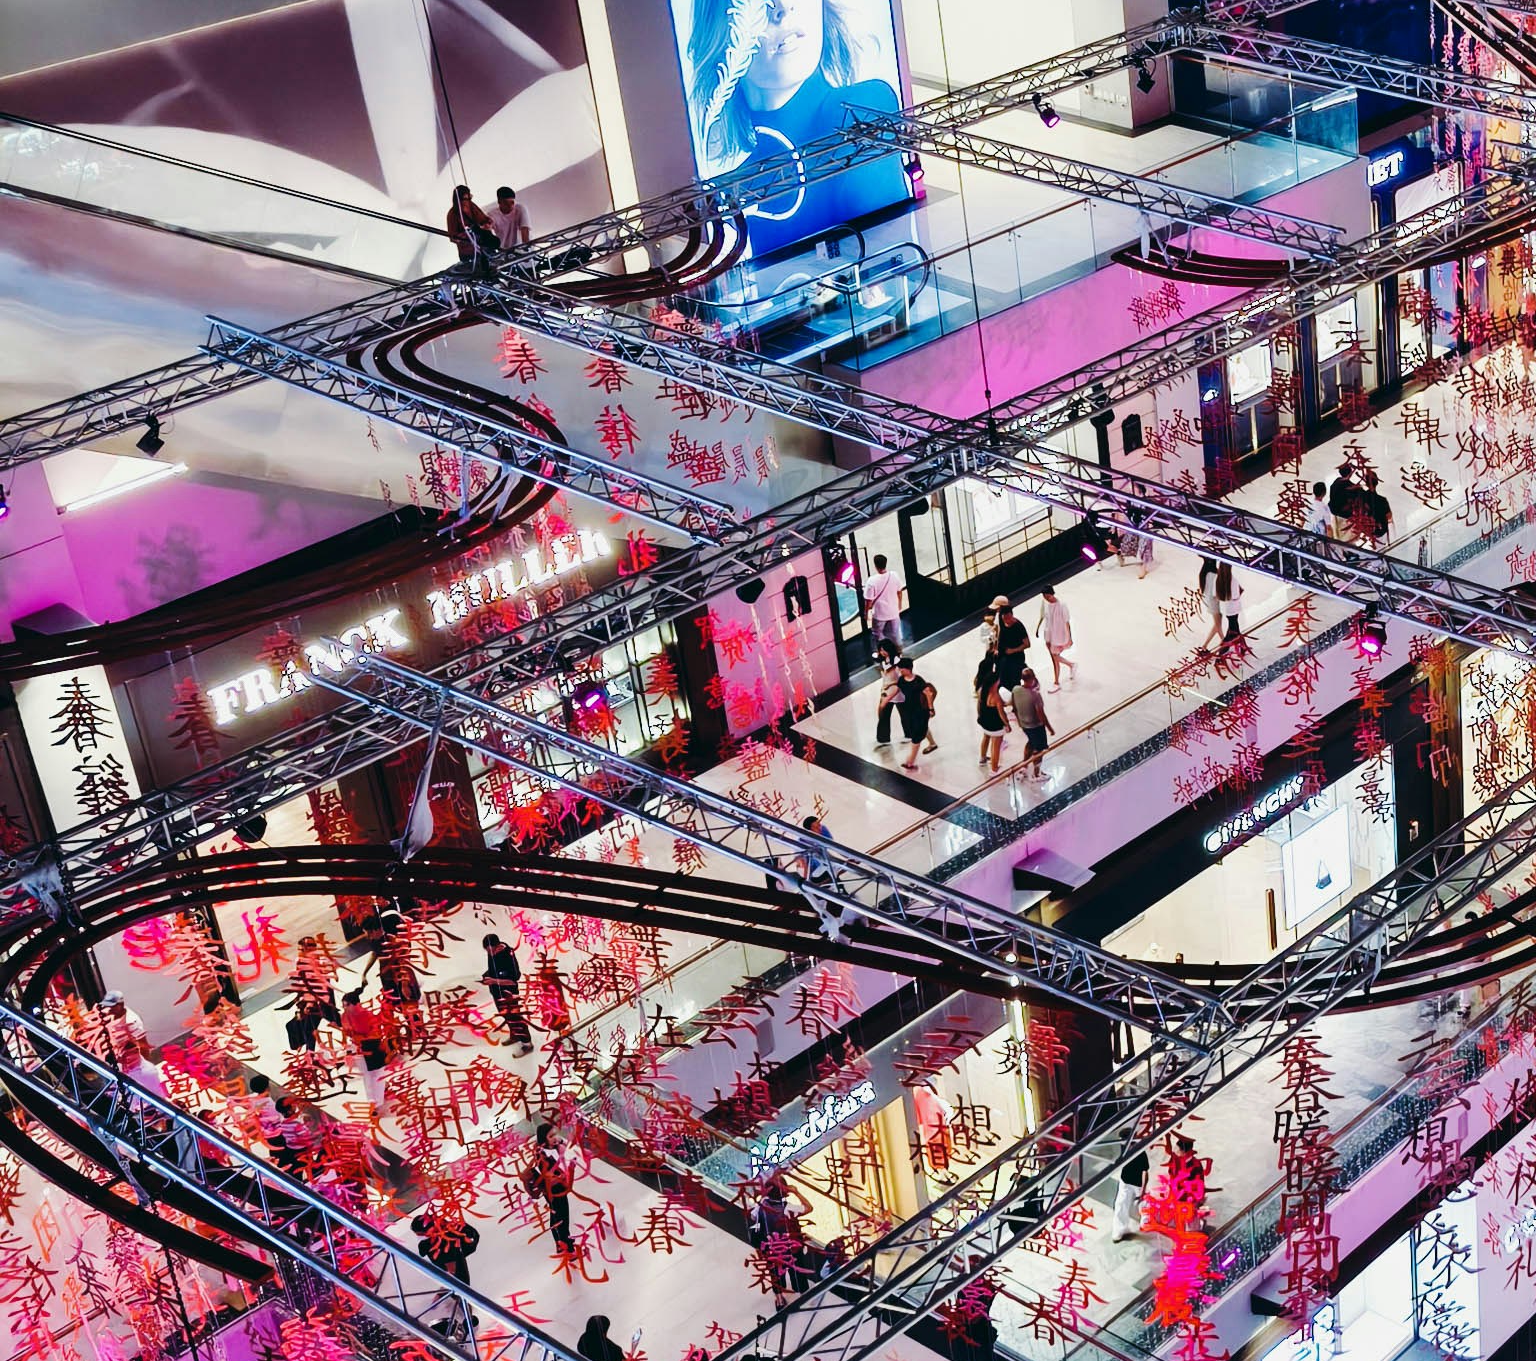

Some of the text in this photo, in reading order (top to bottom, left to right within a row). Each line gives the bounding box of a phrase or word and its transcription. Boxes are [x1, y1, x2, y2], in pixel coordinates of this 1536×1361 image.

[207, 530, 612, 726] FRANCK MULLER
[634, 1206, 693, 1255] 春
[550, 1240, 609, 1284] 礼
[1019, 1295, 1075, 1345] 春
